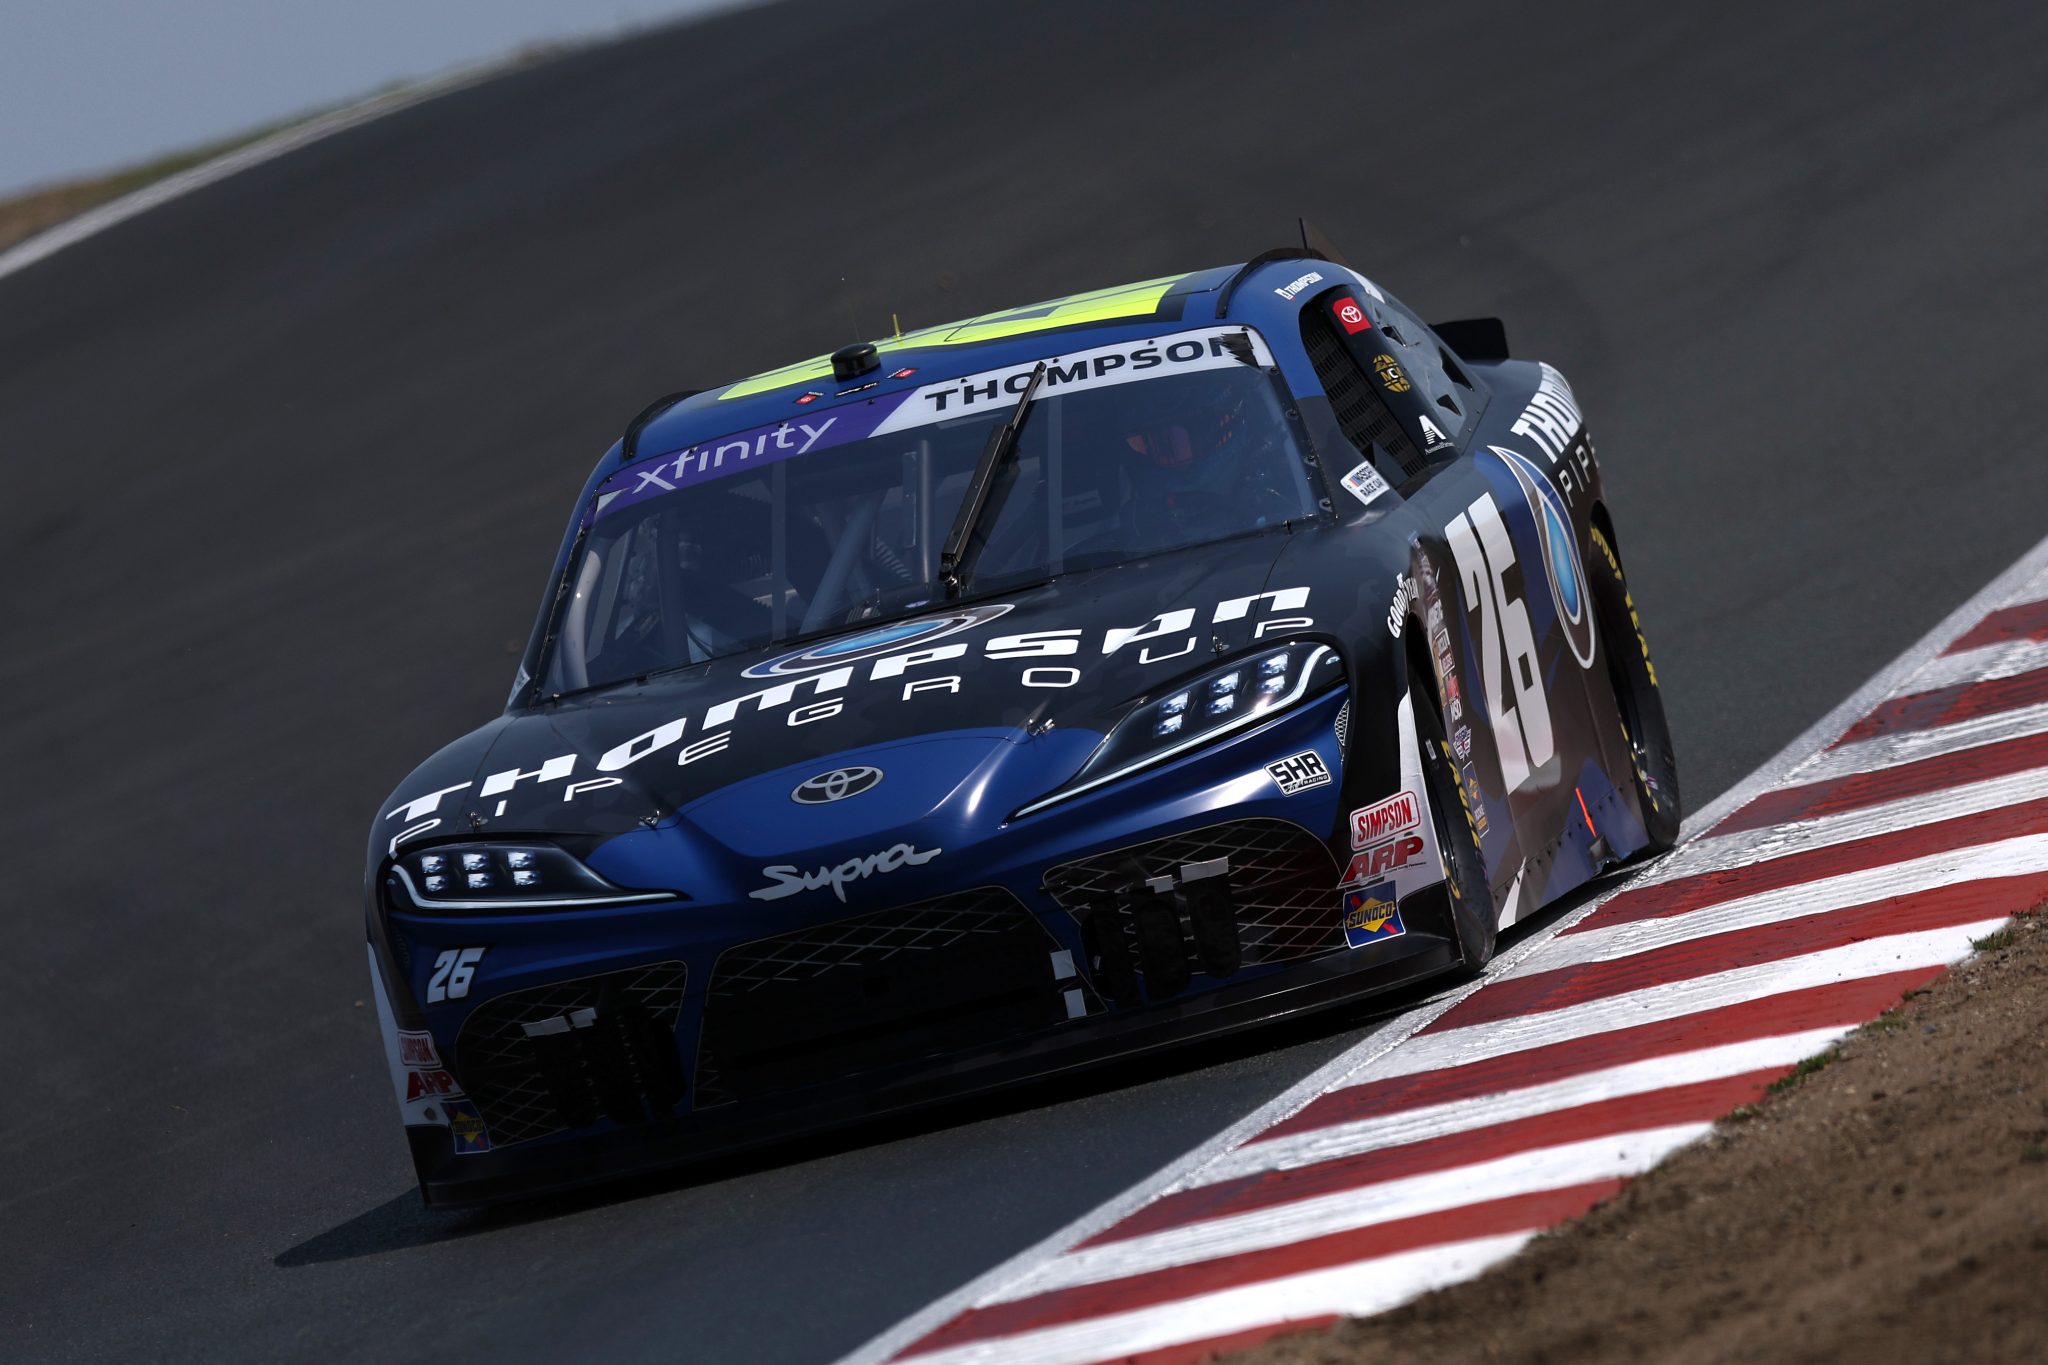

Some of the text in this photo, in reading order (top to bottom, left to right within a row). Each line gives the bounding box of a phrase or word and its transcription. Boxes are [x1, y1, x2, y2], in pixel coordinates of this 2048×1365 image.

[632, 416, 838, 494] xfinity
[1444, 492, 1554, 795] 26
[385, 586, 1311, 823] THOMPSON
[388, 731, 731, 861] PIPE
[786, 617, 1314, 727] GROUP
[1268, 753, 1326, 786] SHR
[1357, 797, 1413, 843] SIMPSON
[748, 843, 942, 904] Supra
[1341, 835, 1424, 884] ARP
[1349, 901, 1393, 927] SUNOCO
[426, 947, 487, 1005] 26
